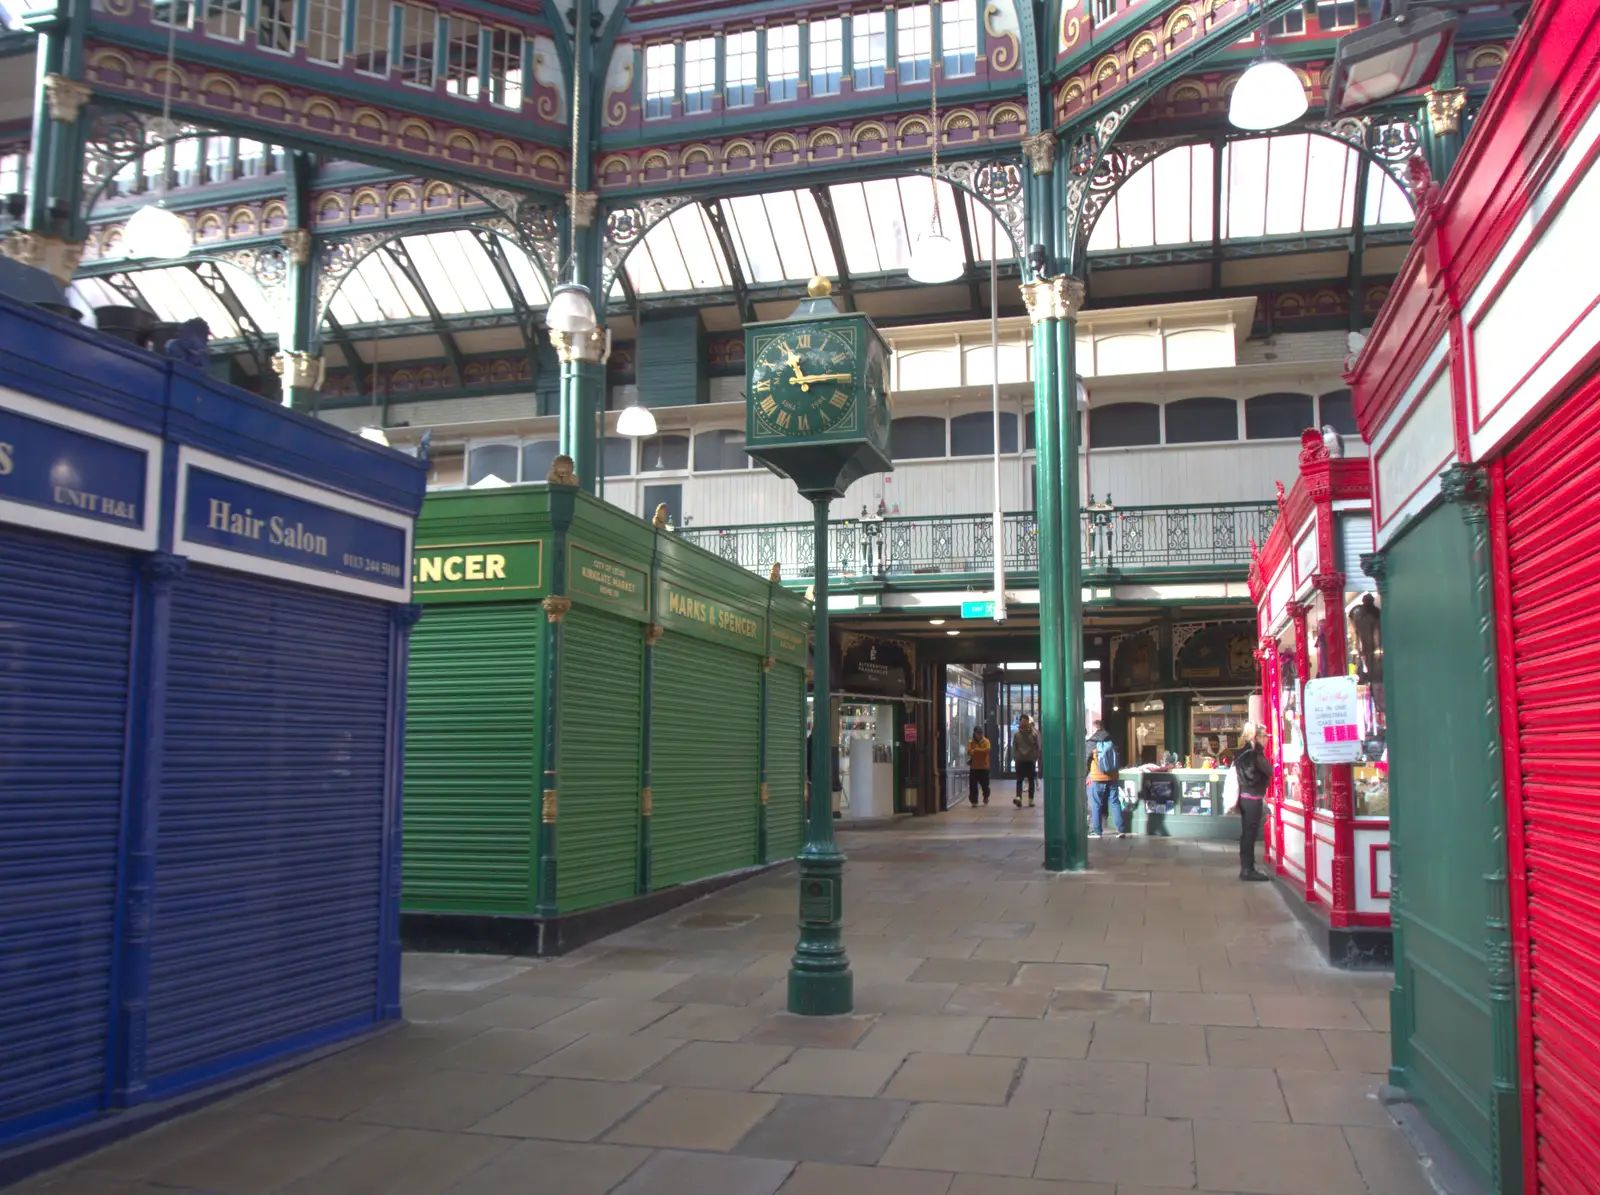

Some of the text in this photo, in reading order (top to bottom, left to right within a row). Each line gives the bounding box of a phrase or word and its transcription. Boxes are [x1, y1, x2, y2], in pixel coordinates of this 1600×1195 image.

[54, 485, 136, 520] UNIT H&I
[207, 498, 328, 556] Hair Salon
[581, 566, 636, 593] KIRKGATE MARKET
[669, 591, 706, 623] MARKS
[709, 604, 716, 626] &
[718, 609, 758, 640] SPENCER
